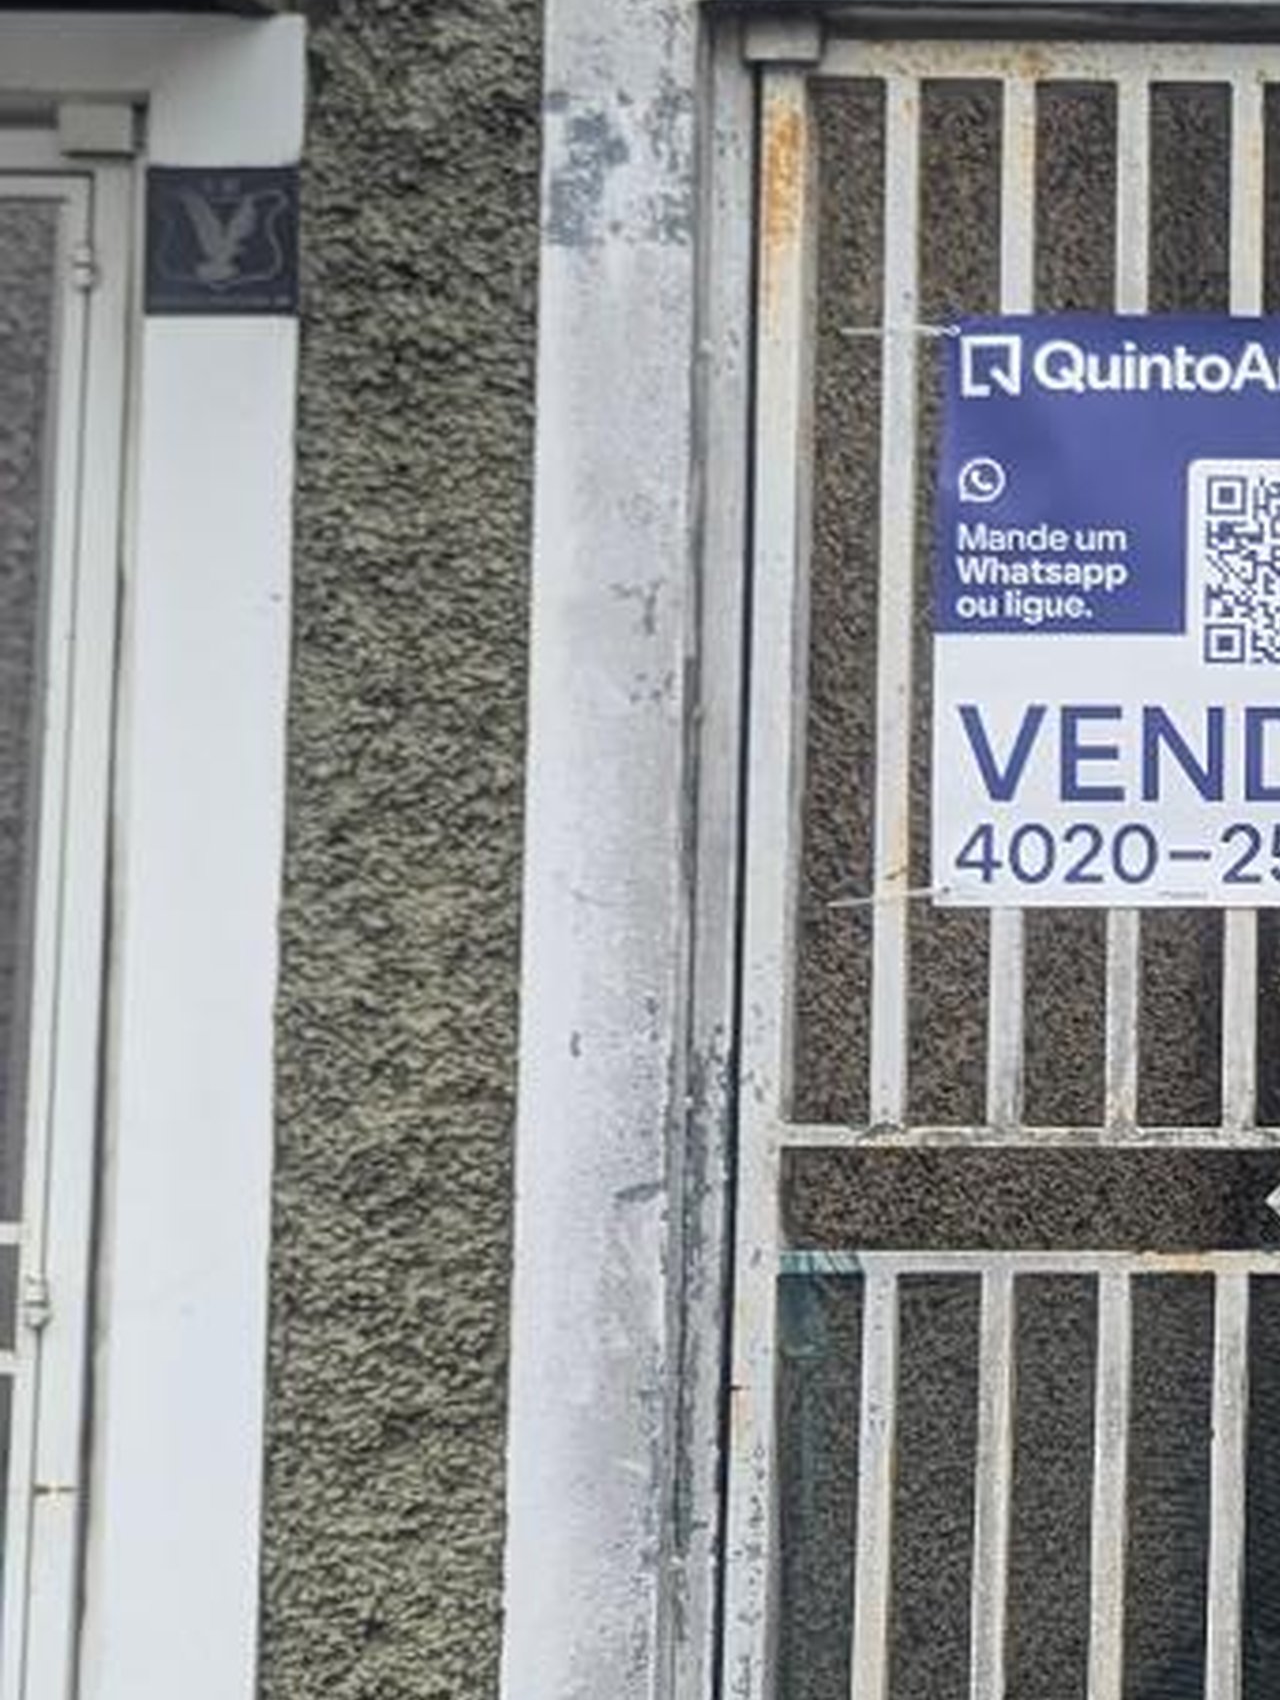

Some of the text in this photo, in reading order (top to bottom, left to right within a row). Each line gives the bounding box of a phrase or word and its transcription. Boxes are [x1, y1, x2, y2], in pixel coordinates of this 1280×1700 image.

[957, 523, 1127, 551] Mande um
[955, 555, 1129, 591] Whatsapp
[955, 589, 1094, 625] ou ligue.
